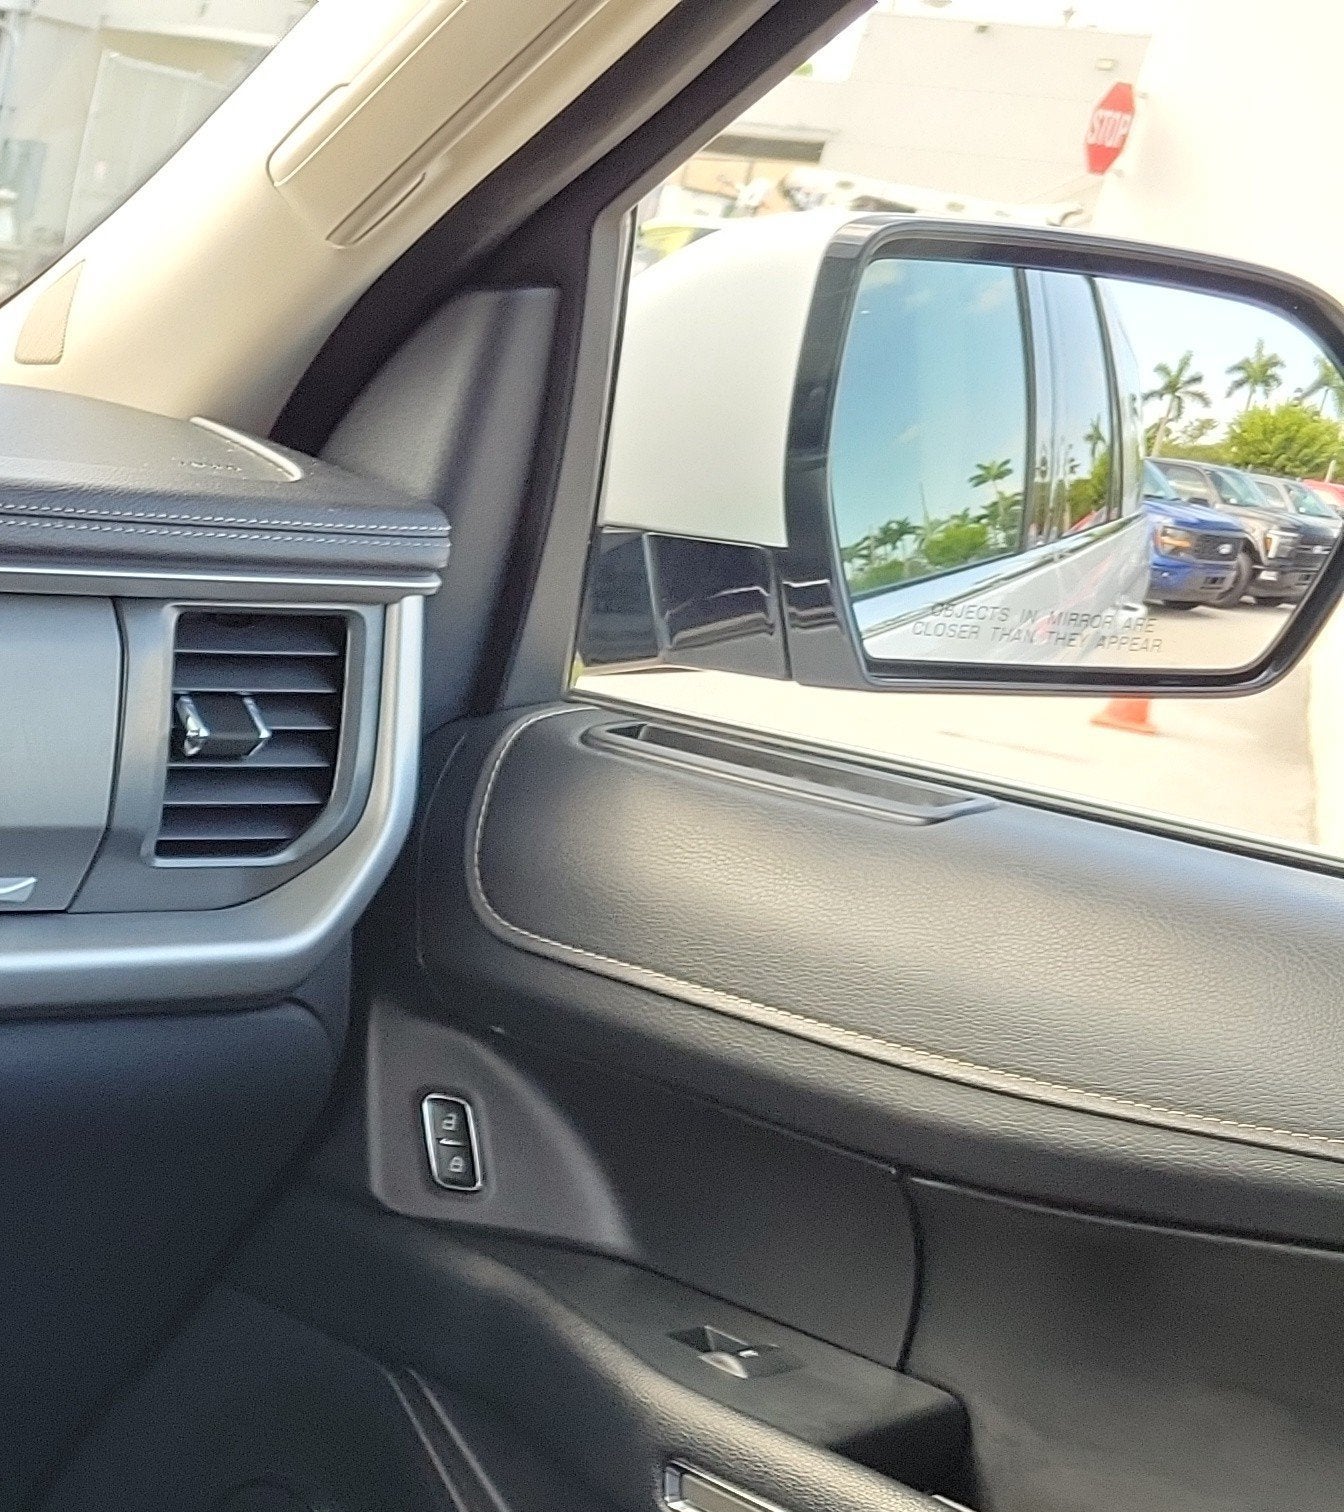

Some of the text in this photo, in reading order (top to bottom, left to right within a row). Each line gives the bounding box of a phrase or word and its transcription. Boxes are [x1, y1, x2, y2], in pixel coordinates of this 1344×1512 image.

[1086, 109, 1134, 149] STOP
[931, 602, 1159, 634] OBJECTS IN MIRROR ARE
[911, 621, 1162, 653] CLOSER THAN THEY APPEAR
